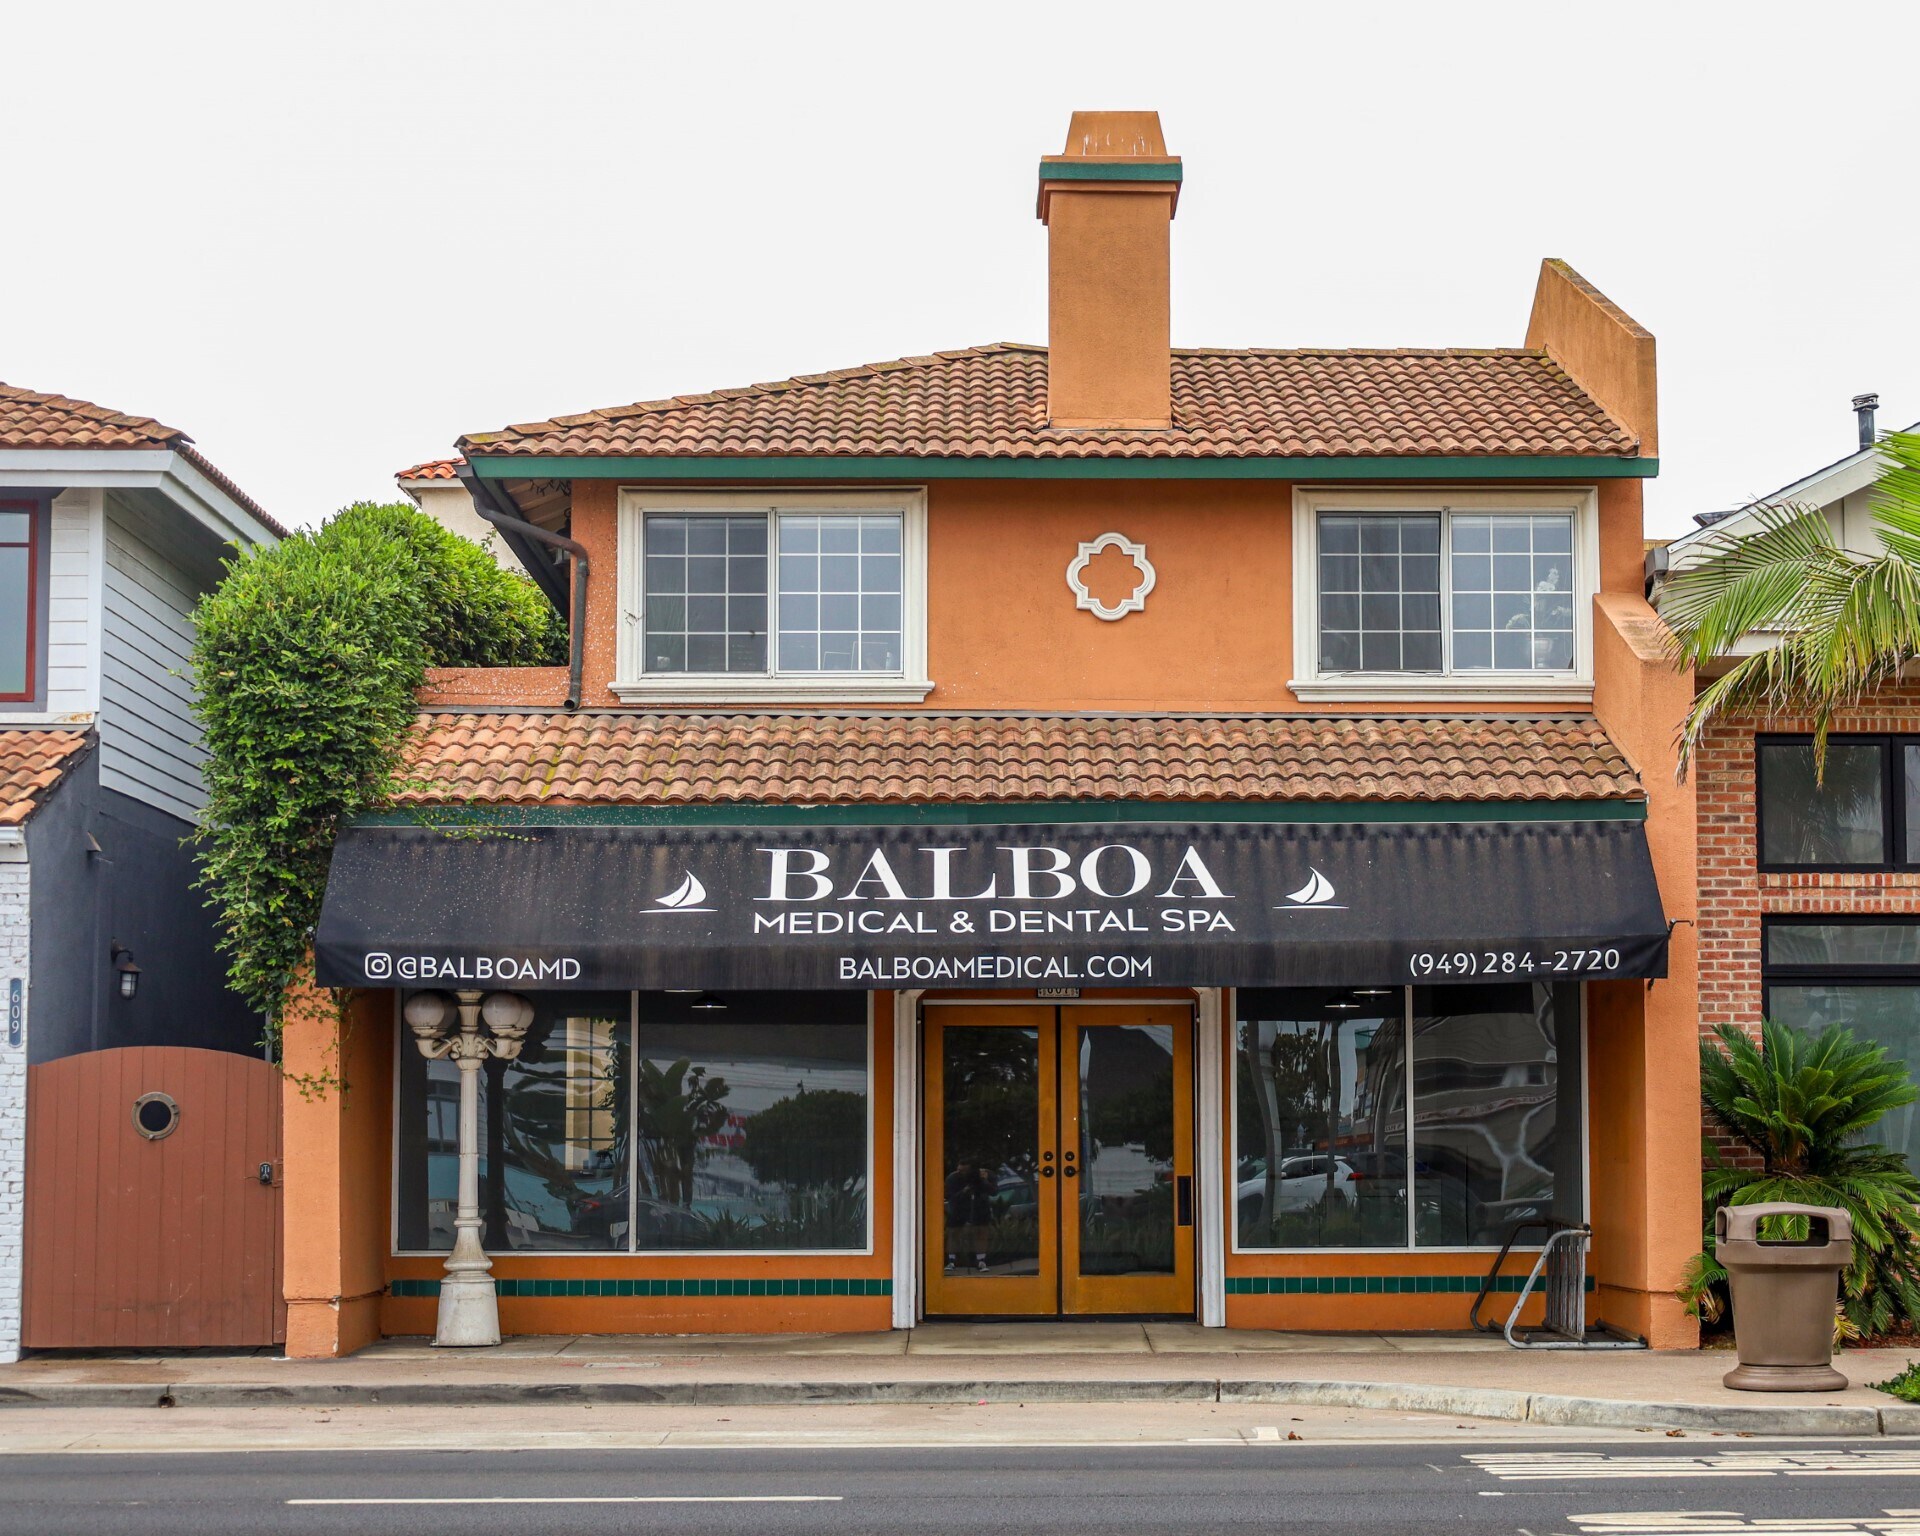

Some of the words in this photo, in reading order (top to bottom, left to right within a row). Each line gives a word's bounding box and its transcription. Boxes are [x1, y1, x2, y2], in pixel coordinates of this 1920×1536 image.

[752, 843, 1236, 902] BALBOA
[753, 910, 938, 936] MEDICAL
[949, 910, 976, 935] &
[989, 908, 1149, 934] DENTAL
[1160, 907, 1237, 934] SPA
[396, 955, 581, 981] @BALBOAMD
[839, 955, 1152, 981] BALBOAMEDICAL.COM
[11, 990, 20, 1034] 609
